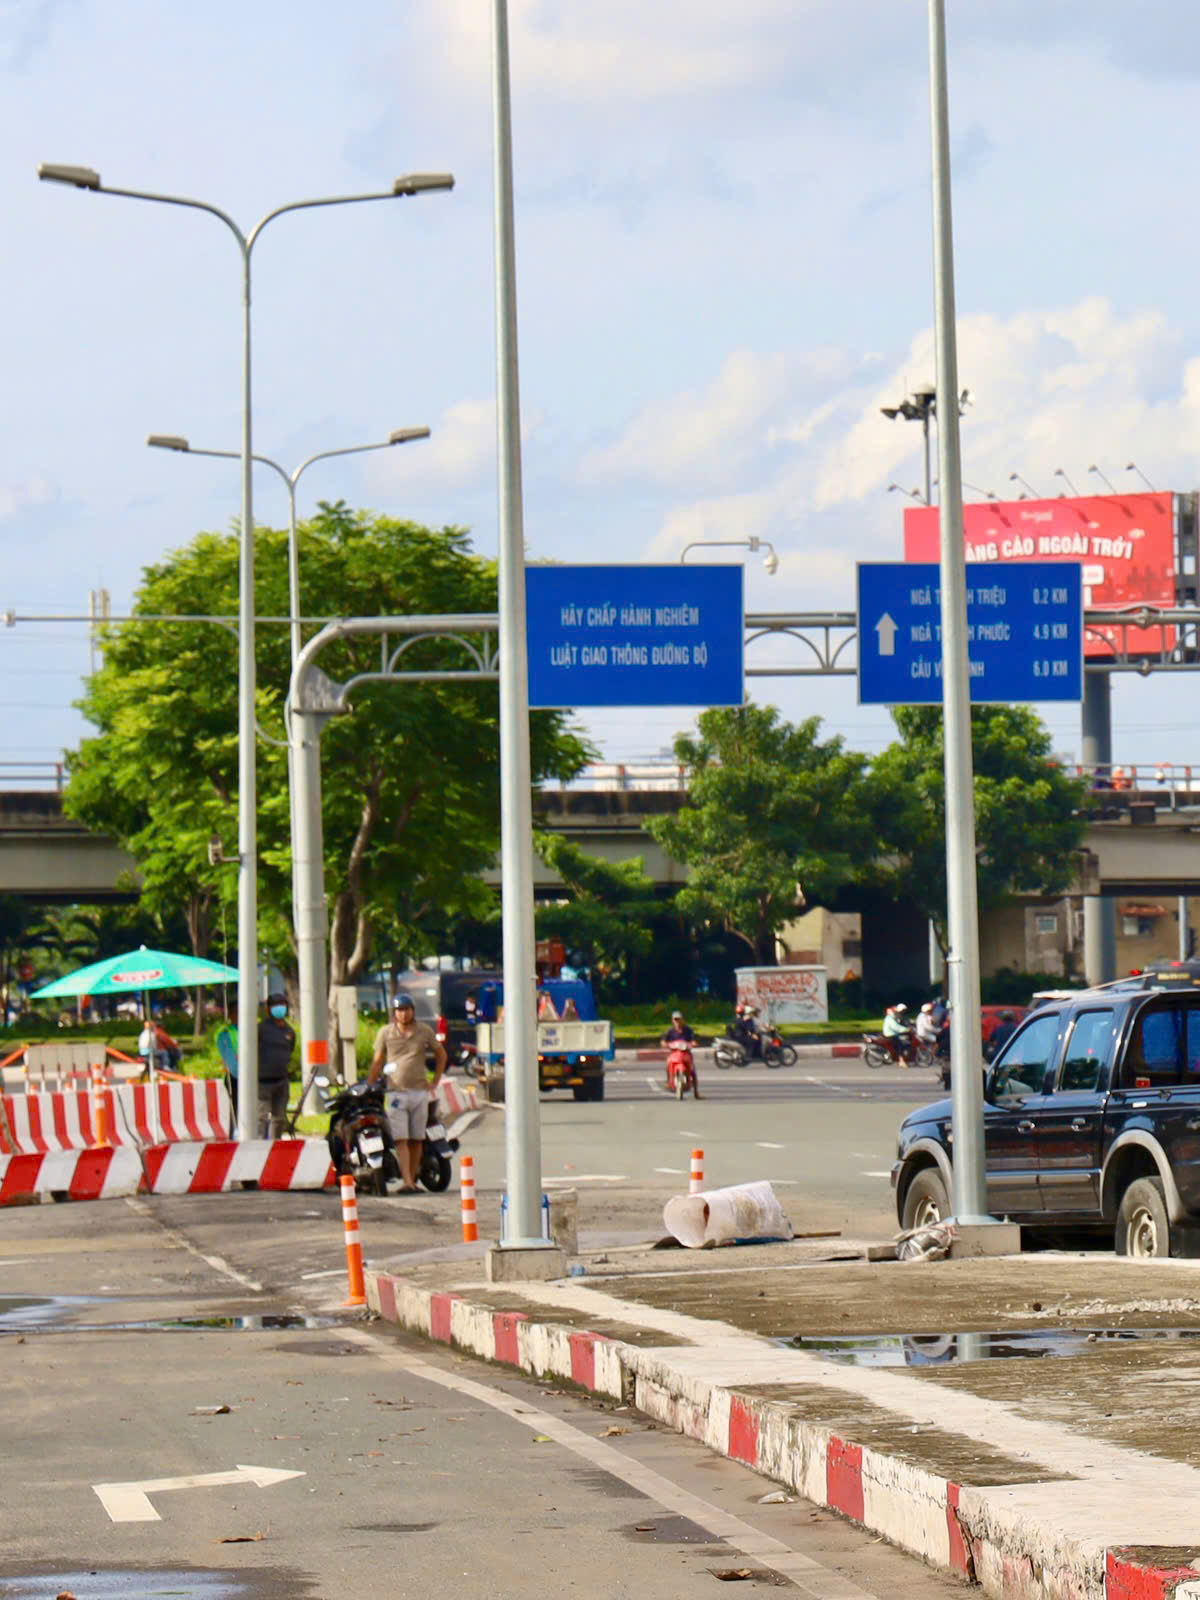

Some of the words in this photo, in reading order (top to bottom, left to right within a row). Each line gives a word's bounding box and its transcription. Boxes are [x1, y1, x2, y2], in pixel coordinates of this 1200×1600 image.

[1039, 532, 1089, 556] NGOÀI
[976, 585, 1007, 608] TRIỆU
[1033, 588, 1049, 605] 0.2
[1052, 588, 1068, 604] KM
[620, 602, 651, 626] HÀNH
[655, 602, 699, 627] NGHIÊM
[1033, 623, 1049, 640] 4.9
[1052, 623, 1068, 640] KM
[551, 642, 578, 669] LUẬT
[581, 646, 608, 666] GIAO
[611, 642, 648, 666] THÔNG
[693, 641, 708, 669] BỘ
[1033, 659, 1049, 677] 6.0
[1052, 660, 1068, 677] KM
